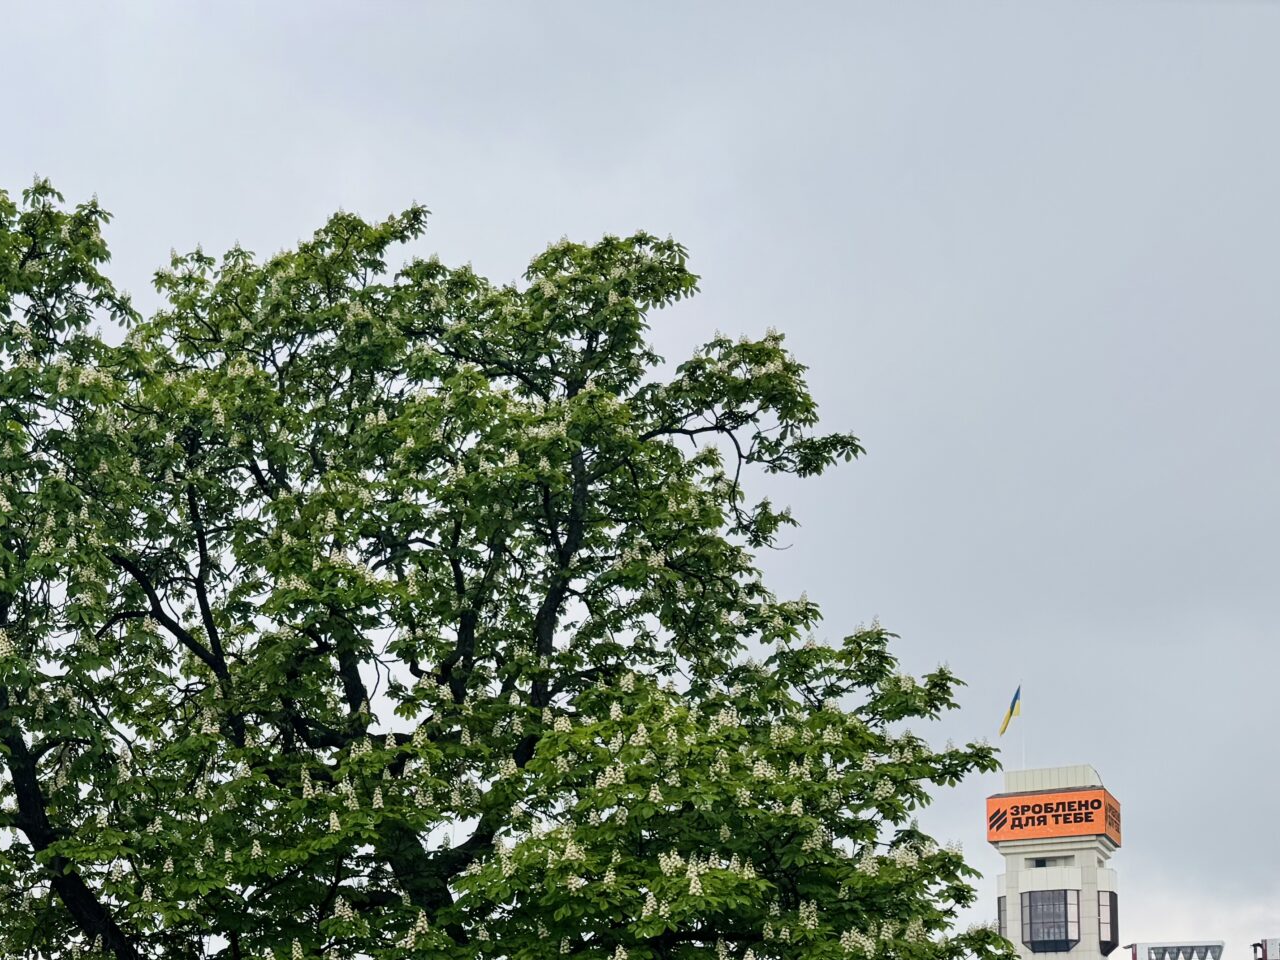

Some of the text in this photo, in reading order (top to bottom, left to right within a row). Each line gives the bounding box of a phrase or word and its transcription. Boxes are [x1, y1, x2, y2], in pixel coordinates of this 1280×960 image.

[1010, 799, 1102, 816] ЗРОБЛЕНО
[1010, 815, 1047, 830] ДЛЯ
[1051, 811, 1094, 825] ТЕБЕ
